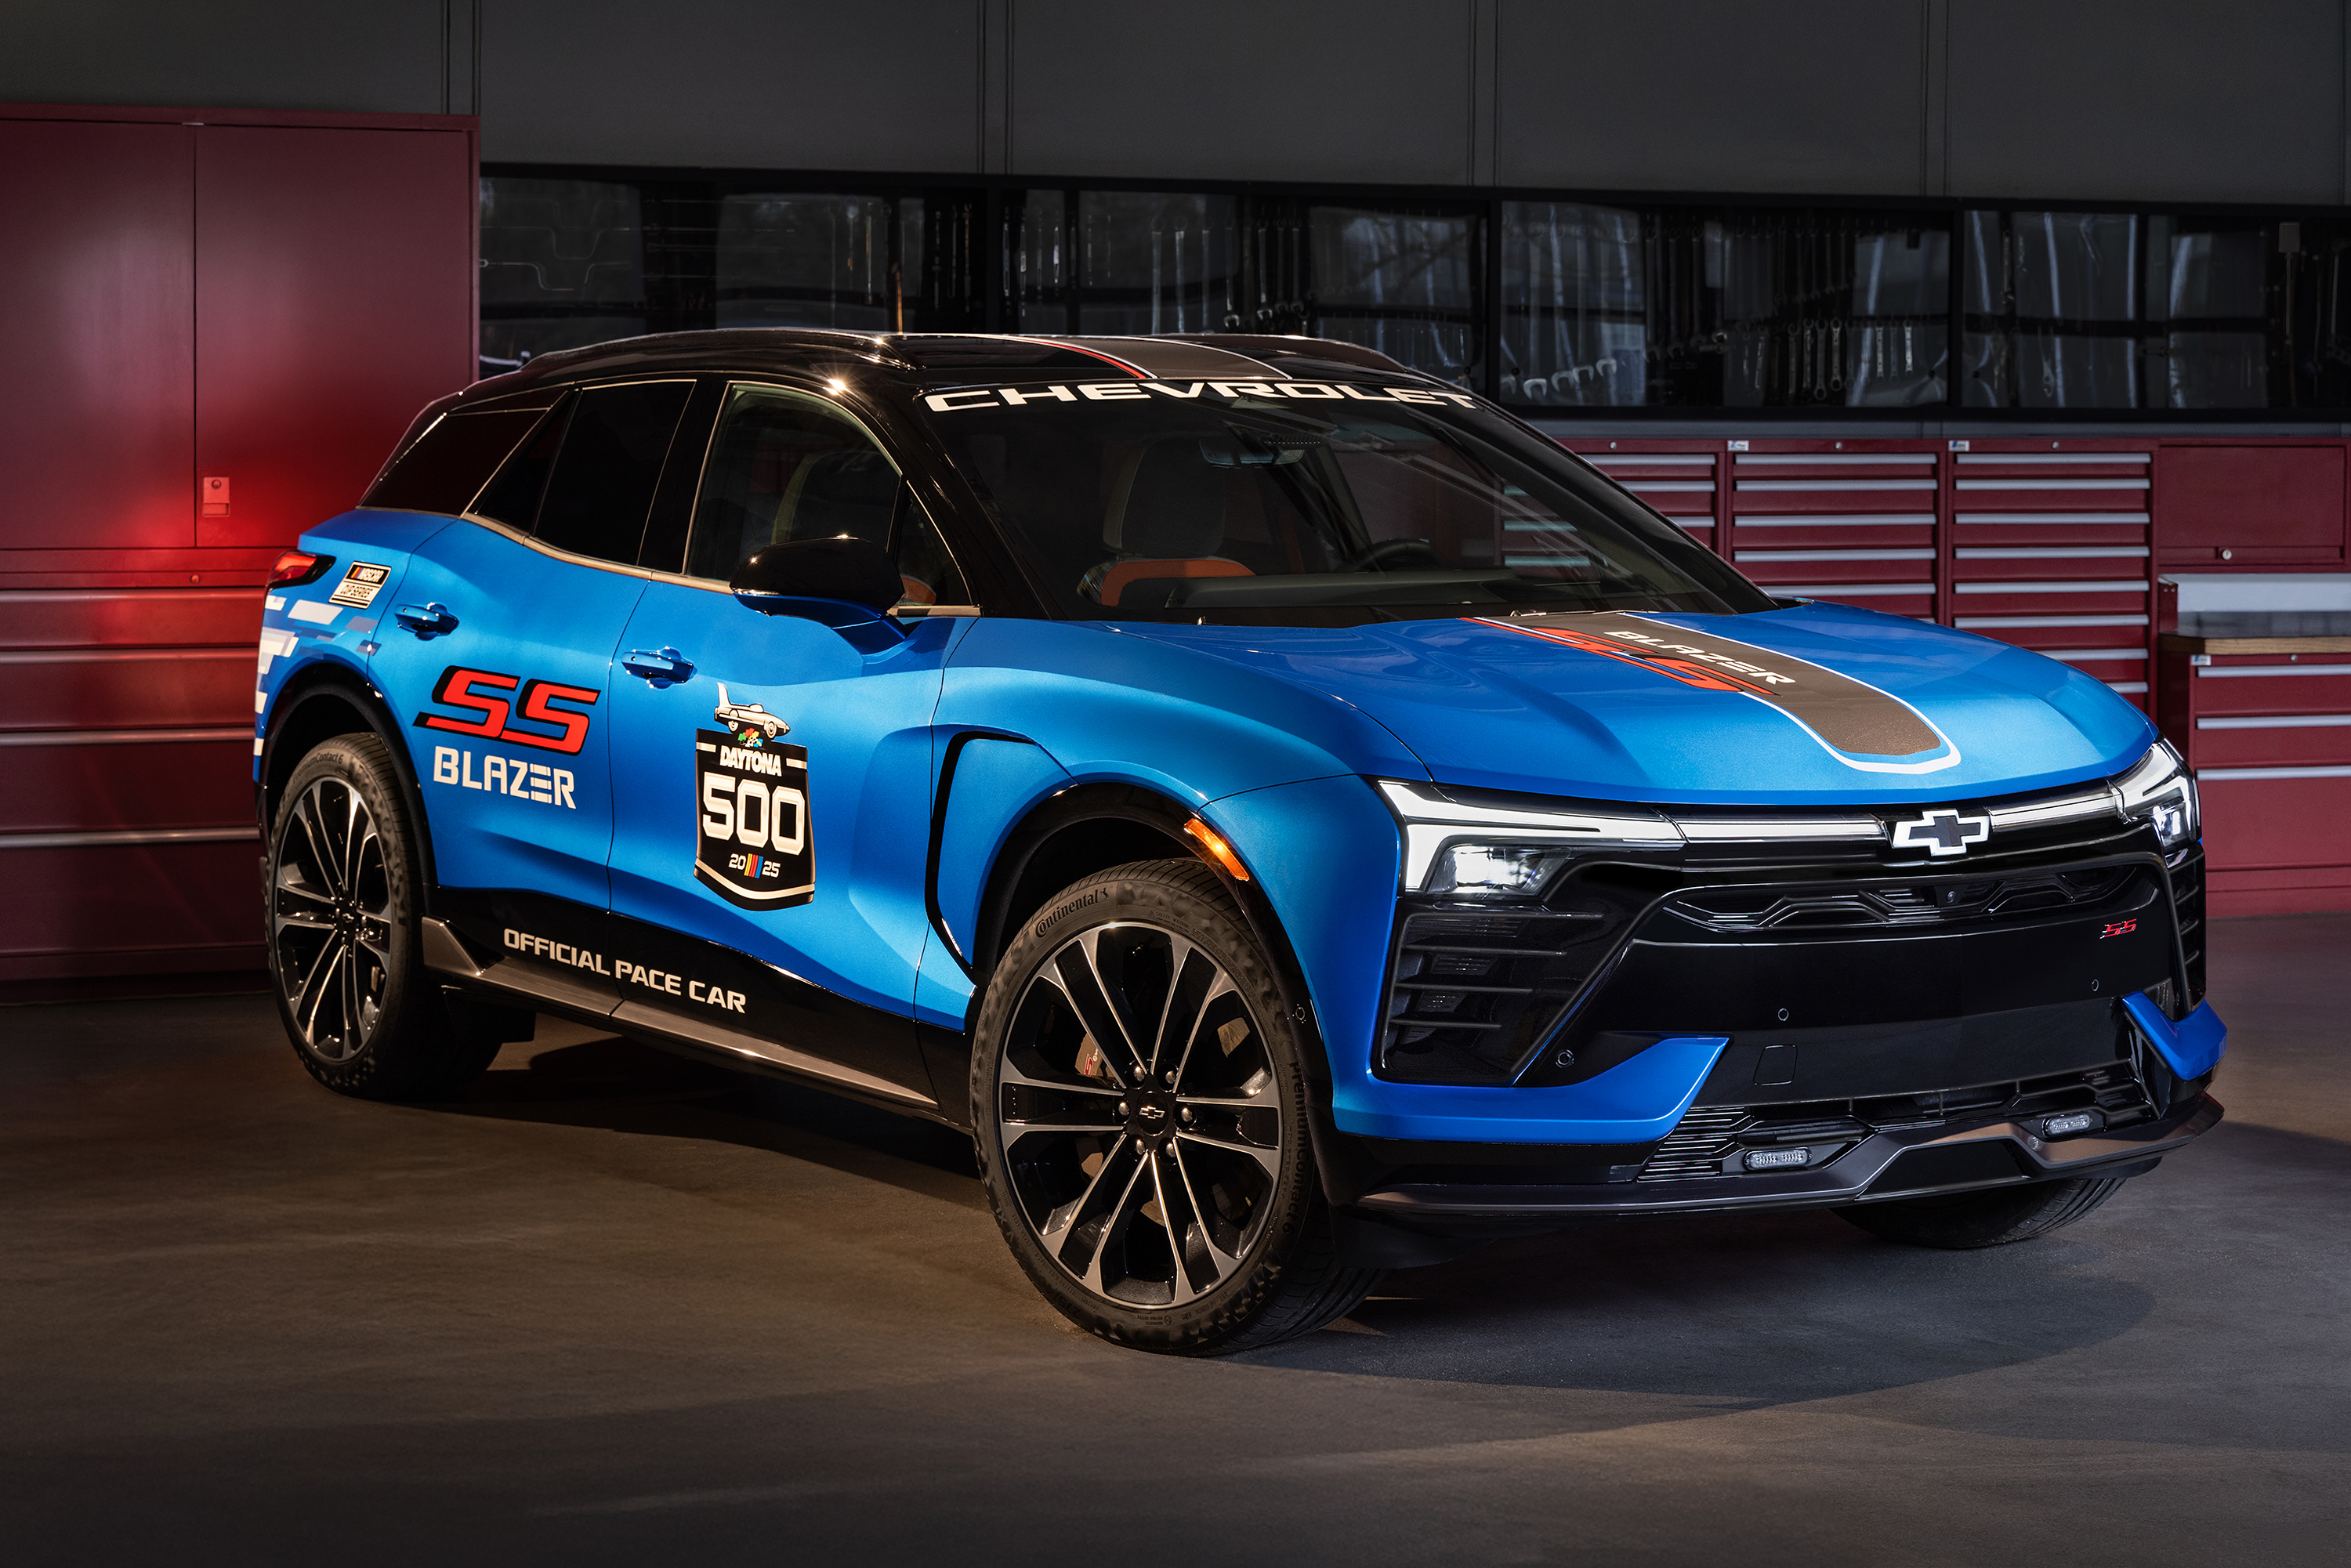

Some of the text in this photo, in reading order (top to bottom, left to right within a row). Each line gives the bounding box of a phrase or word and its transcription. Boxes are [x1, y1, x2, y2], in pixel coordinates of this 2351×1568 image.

[925, 382, 1477, 412] CHEVROLET
[1517, 625, 1782, 696] SS
[1604, 631, 1796, 685] BLAZER
[412, 664, 602, 756] SS
[433, 745, 577, 809] BLAZER
[719, 745, 783, 777] DAYTONA
[702, 771, 806, 856] 500
[1035, 889, 1098, 938] Continental
[2099, 918, 2138, 940] SS
[504, 928, 746, 1014] OFFICIAL PACE CAR
